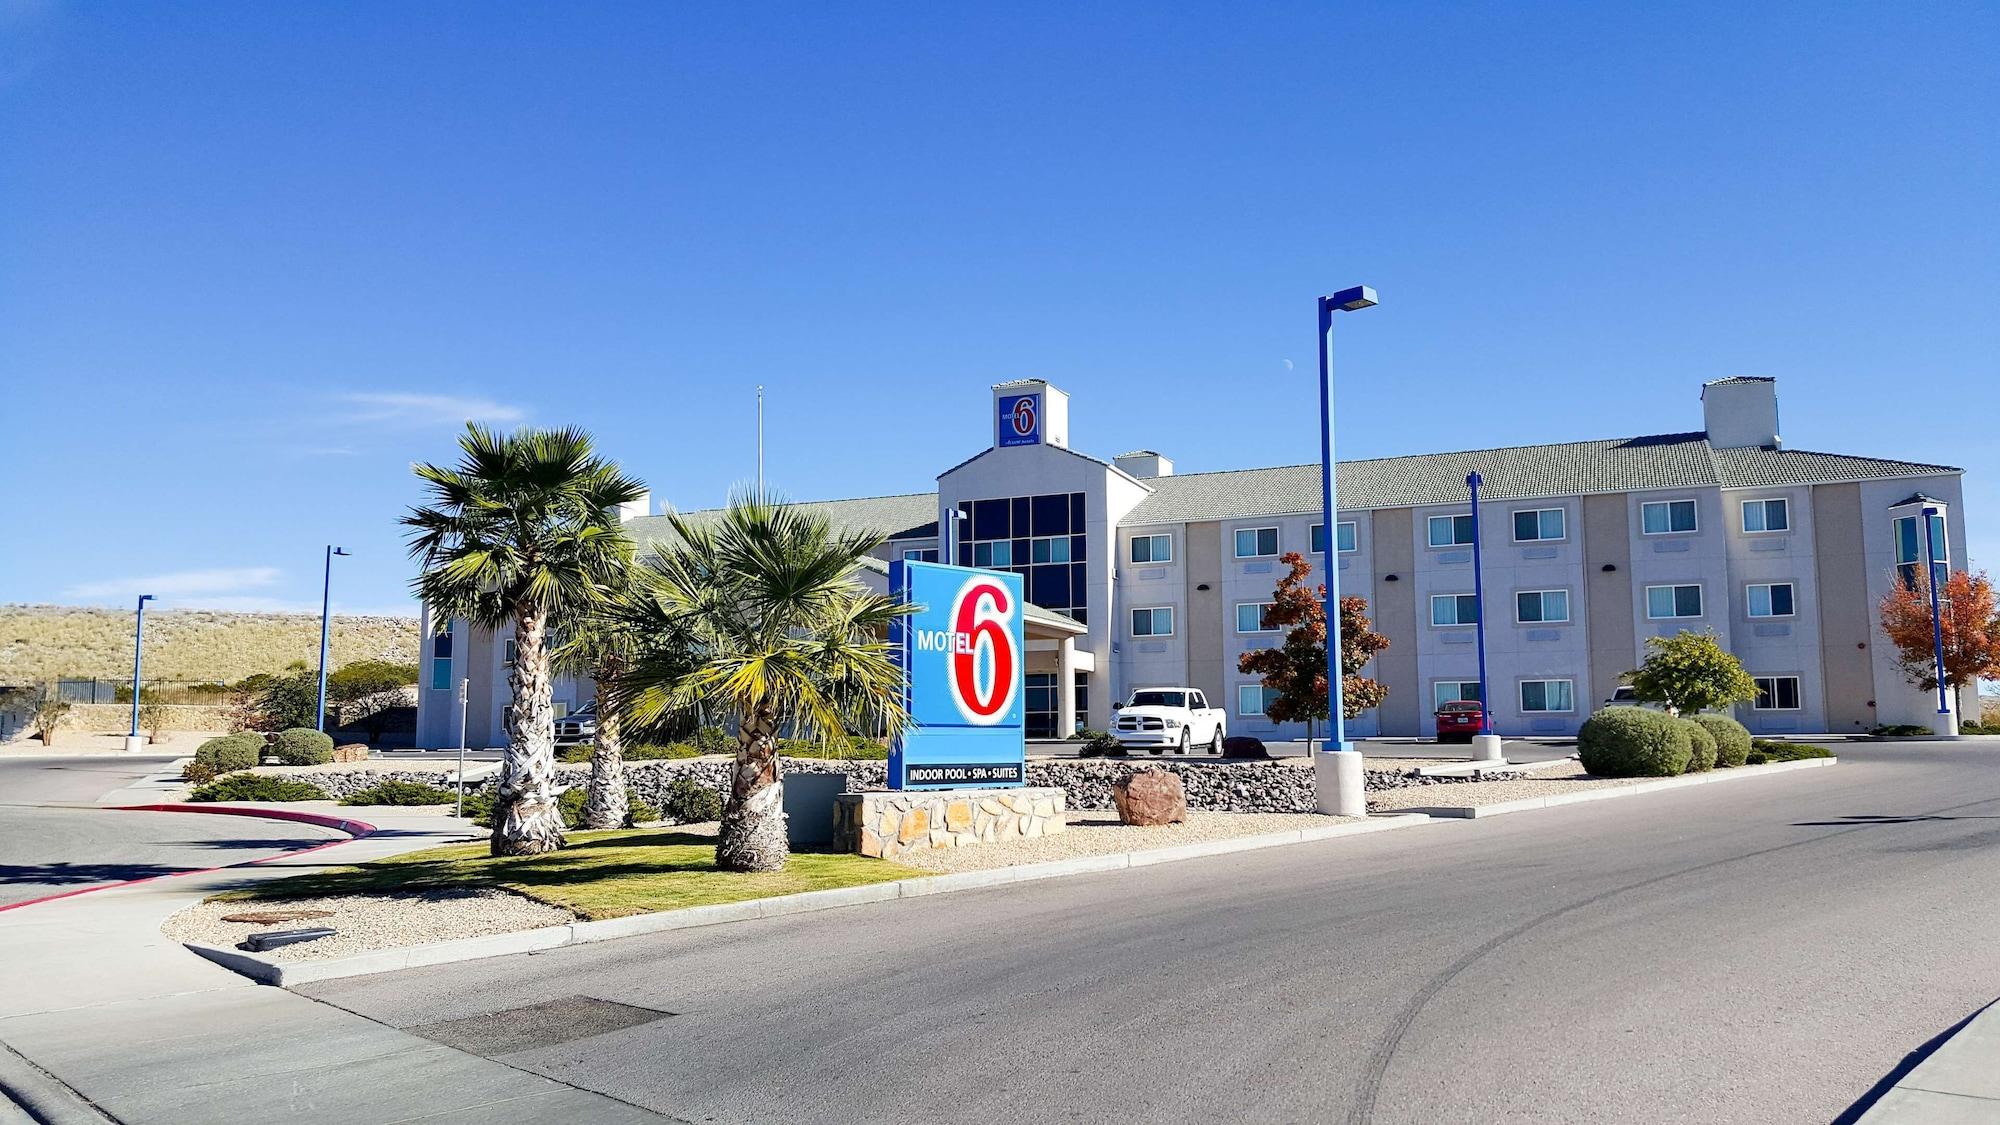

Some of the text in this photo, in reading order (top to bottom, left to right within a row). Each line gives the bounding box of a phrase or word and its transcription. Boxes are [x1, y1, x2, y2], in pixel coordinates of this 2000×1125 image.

[1013, 397, 1035, 435] 6
[918, 583, 1013, 716] MOTEL 6
[910, 767, 1018, 780] INDOOR POOL SPA SUITES
